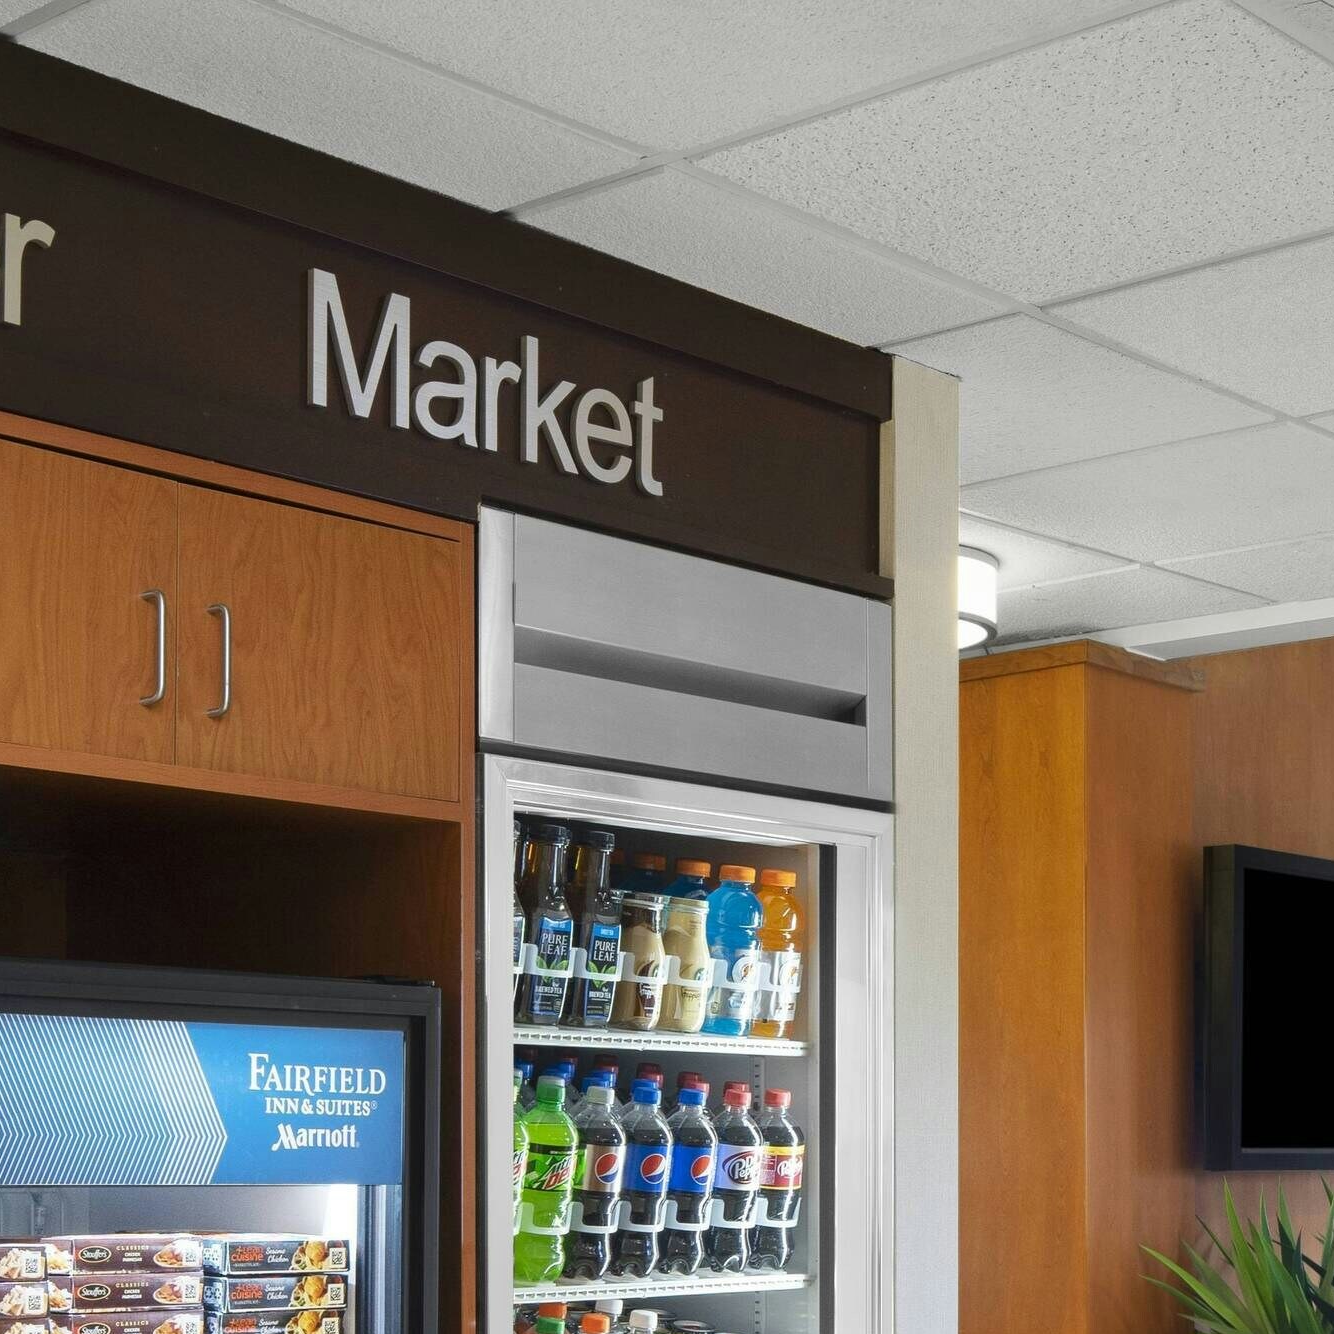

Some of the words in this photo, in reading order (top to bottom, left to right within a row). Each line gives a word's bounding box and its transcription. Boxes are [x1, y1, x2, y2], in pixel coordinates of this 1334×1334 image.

[307, 268, 664, 498] Market
[541, 932, 569, 945] PURE
[594, 940, 616, 952] PURE
[248, 1053, 387, 1097] FAIRFIELD
[265, 1097, 298, 1115] INN
[301, 1098, 314, 1115] &
[271, 1123, 358, 1152] Marriott
